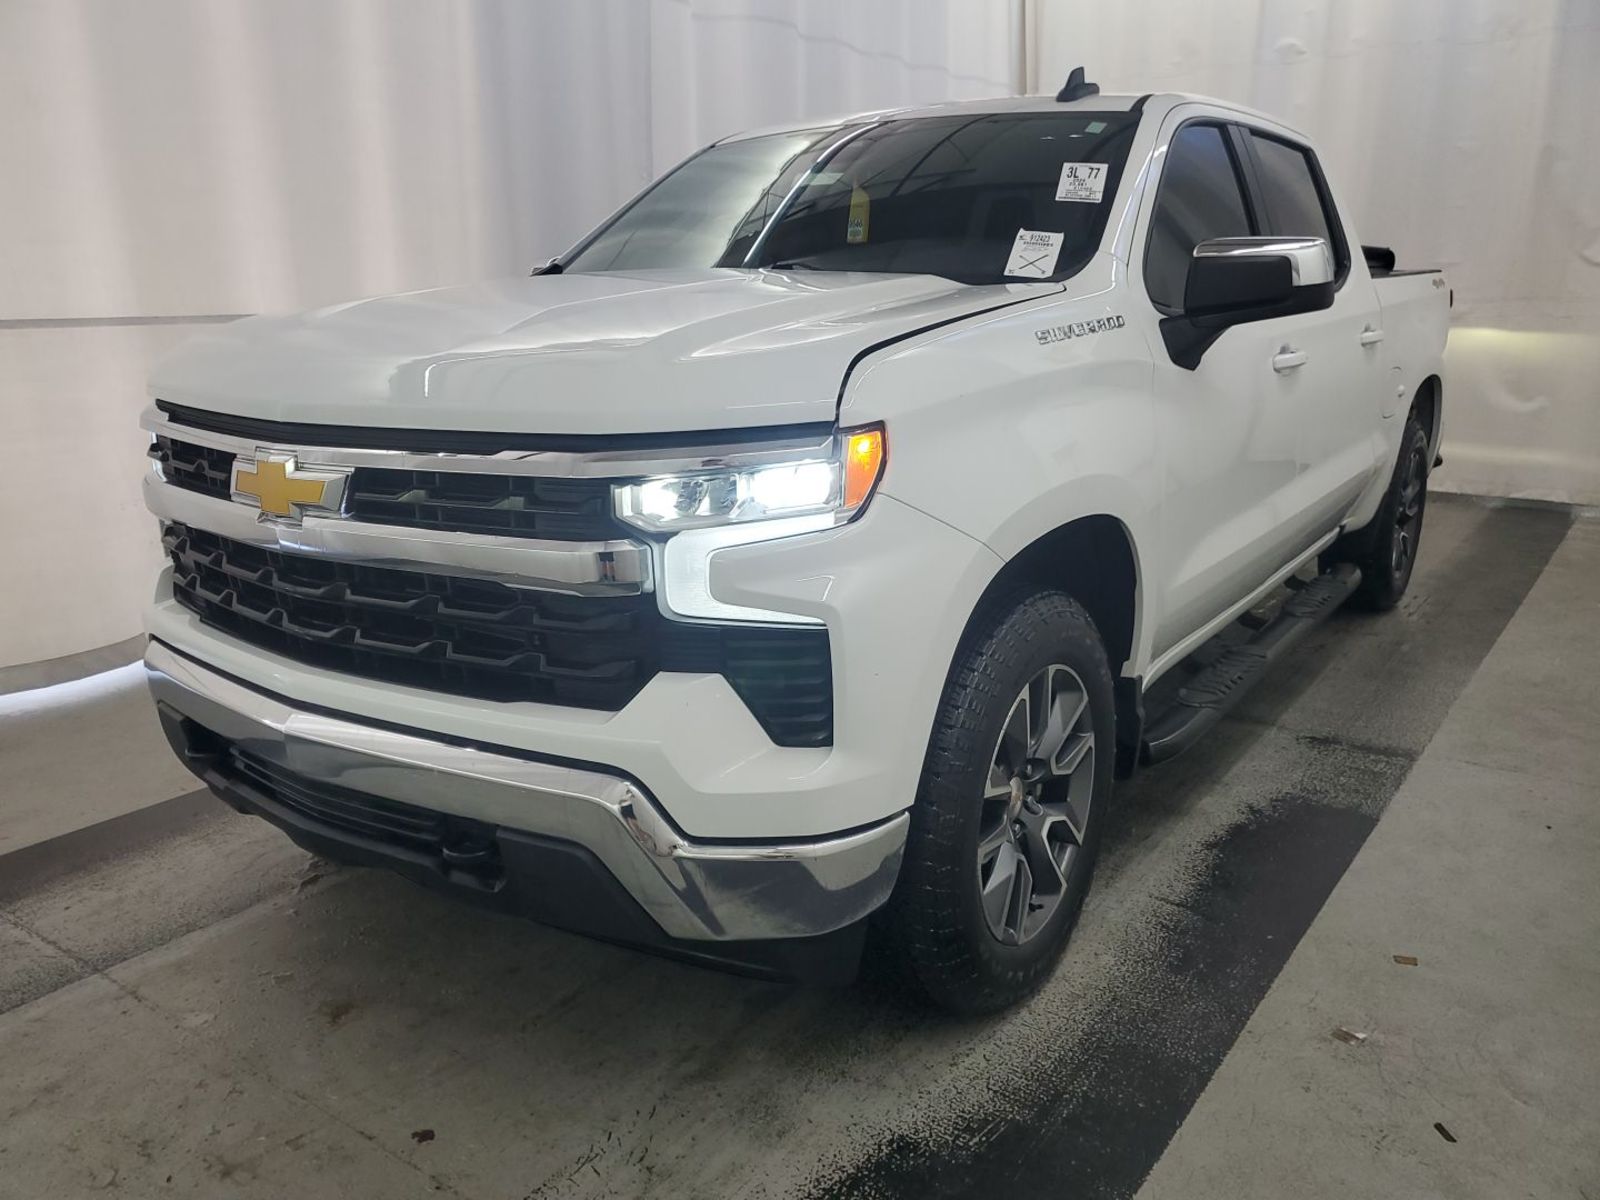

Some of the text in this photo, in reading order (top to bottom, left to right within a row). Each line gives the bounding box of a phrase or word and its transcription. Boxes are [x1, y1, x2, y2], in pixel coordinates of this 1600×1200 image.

[1066, 167, 1101, 180] 3L 77
[1035, 315, 1125, 345] SILVERADO
